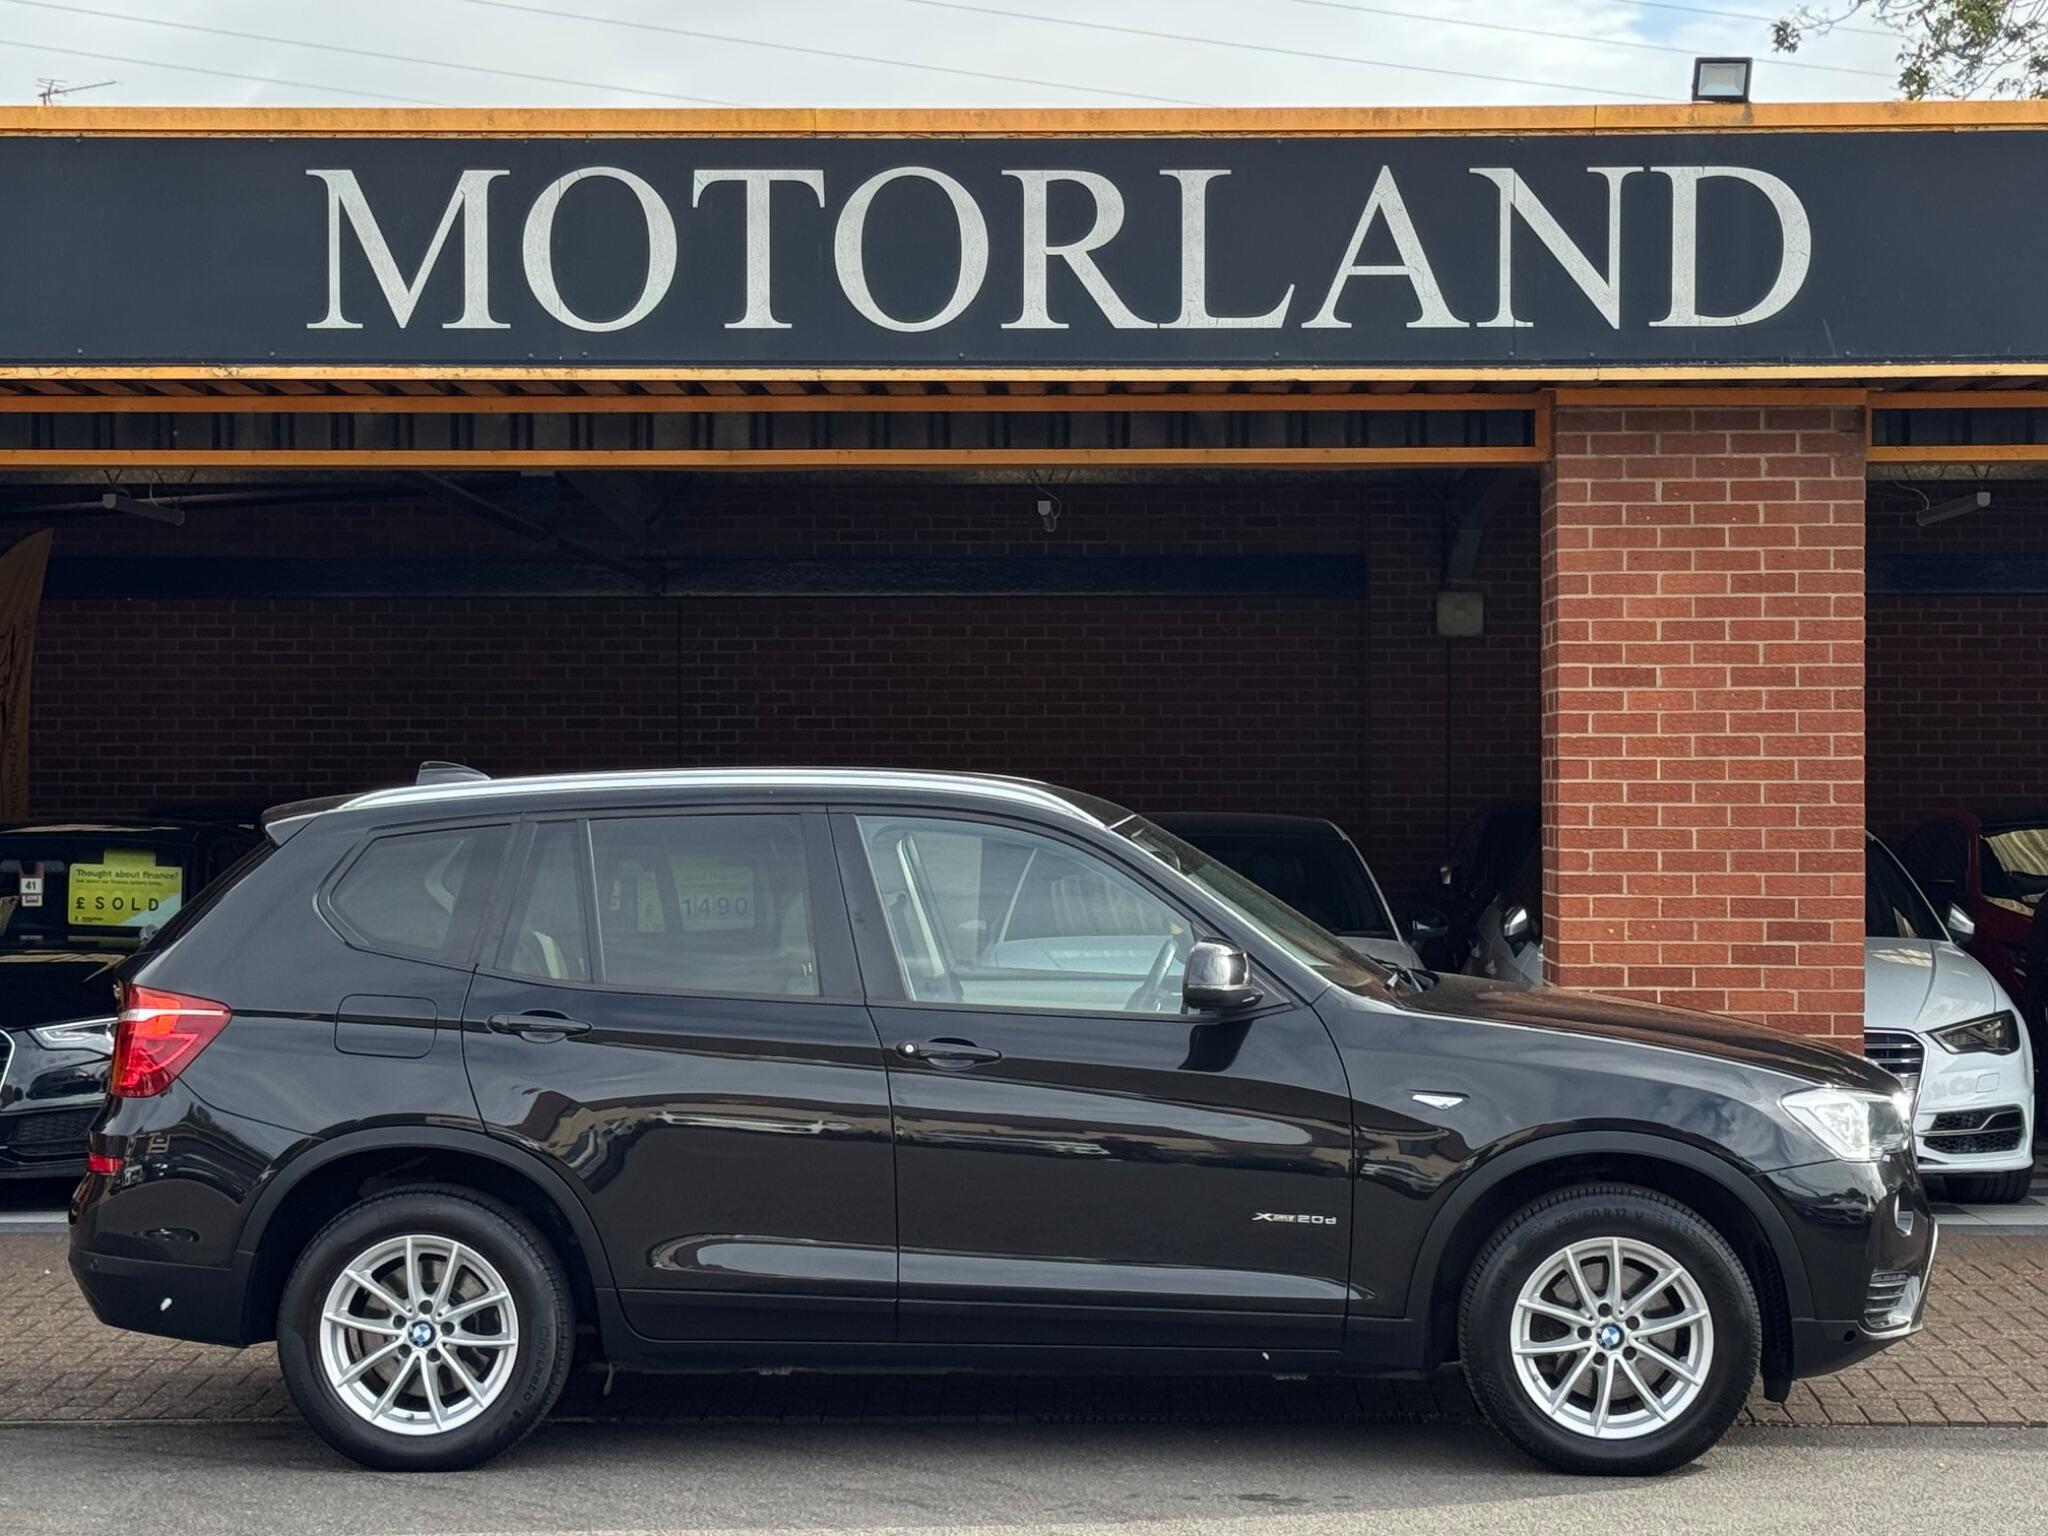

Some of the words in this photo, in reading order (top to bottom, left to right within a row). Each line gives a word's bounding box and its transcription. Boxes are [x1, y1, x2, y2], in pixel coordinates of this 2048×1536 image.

[305, 165, 1812, 332] MOTORLAND
[76, 868, 112, 879] Thought
[115, 869, 140, 879] about
[143, 870, 179, 880] finance?
[25, 879, 37, 891] 41
[75, 896, 86, 910] £
[94, 896, 160, 912] SOLD
